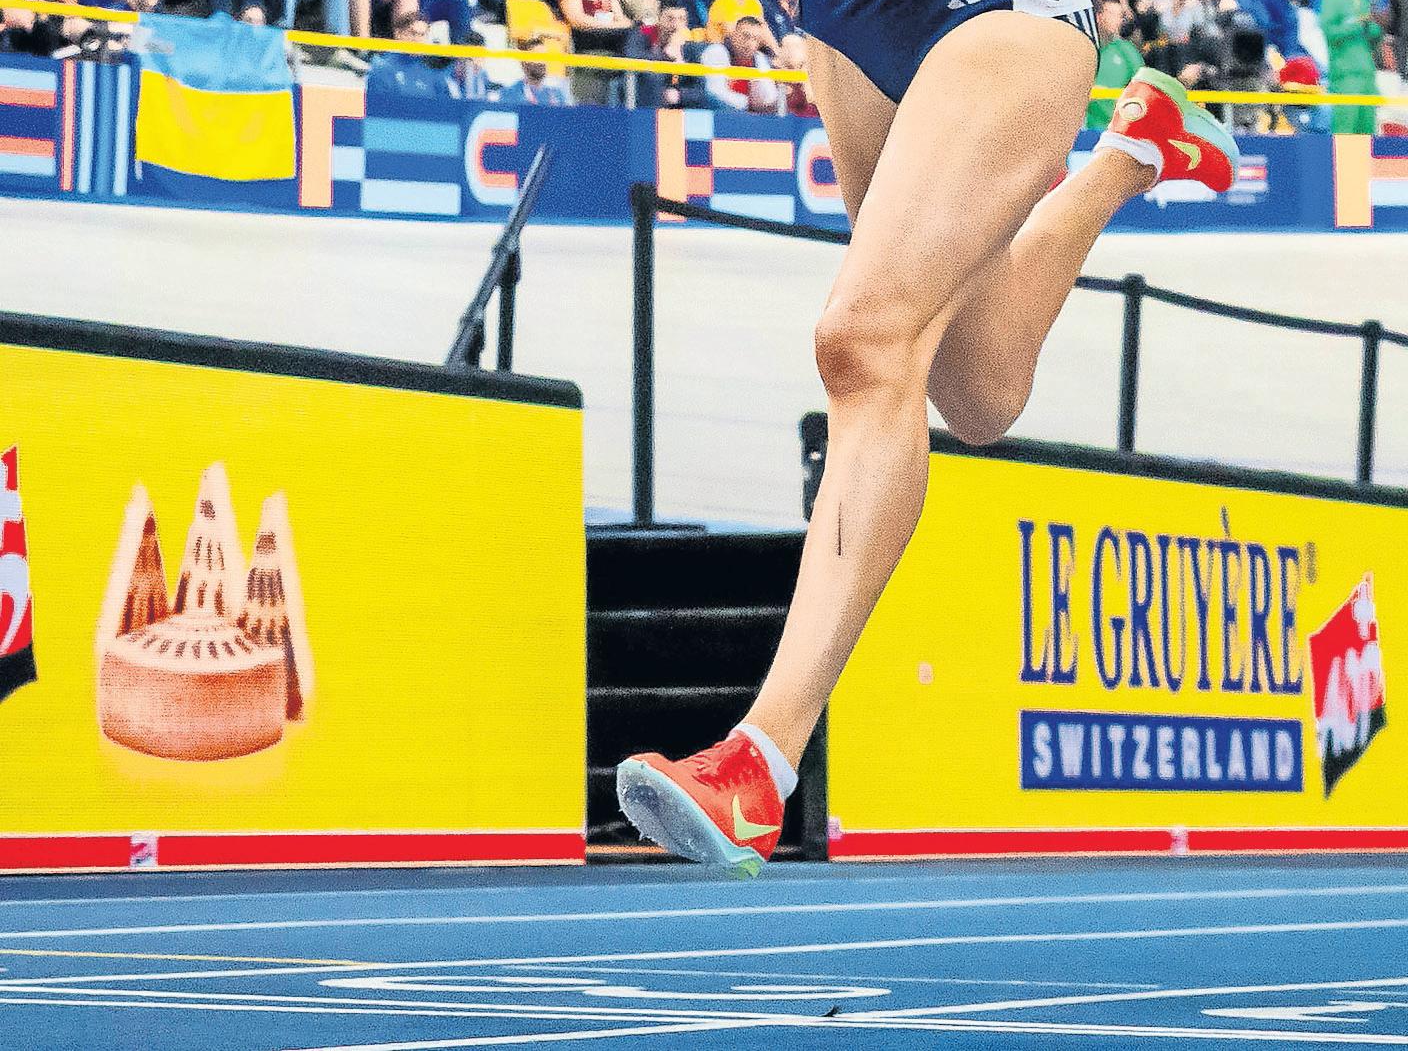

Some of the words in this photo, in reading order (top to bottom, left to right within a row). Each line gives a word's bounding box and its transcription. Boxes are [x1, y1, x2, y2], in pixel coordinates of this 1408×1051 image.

[1017, 518, 1079, 685] LE
[1091, 505, 1304, 694] GRUYÈRE
[1031, 722, 1296, 782] SWITZERLAND
